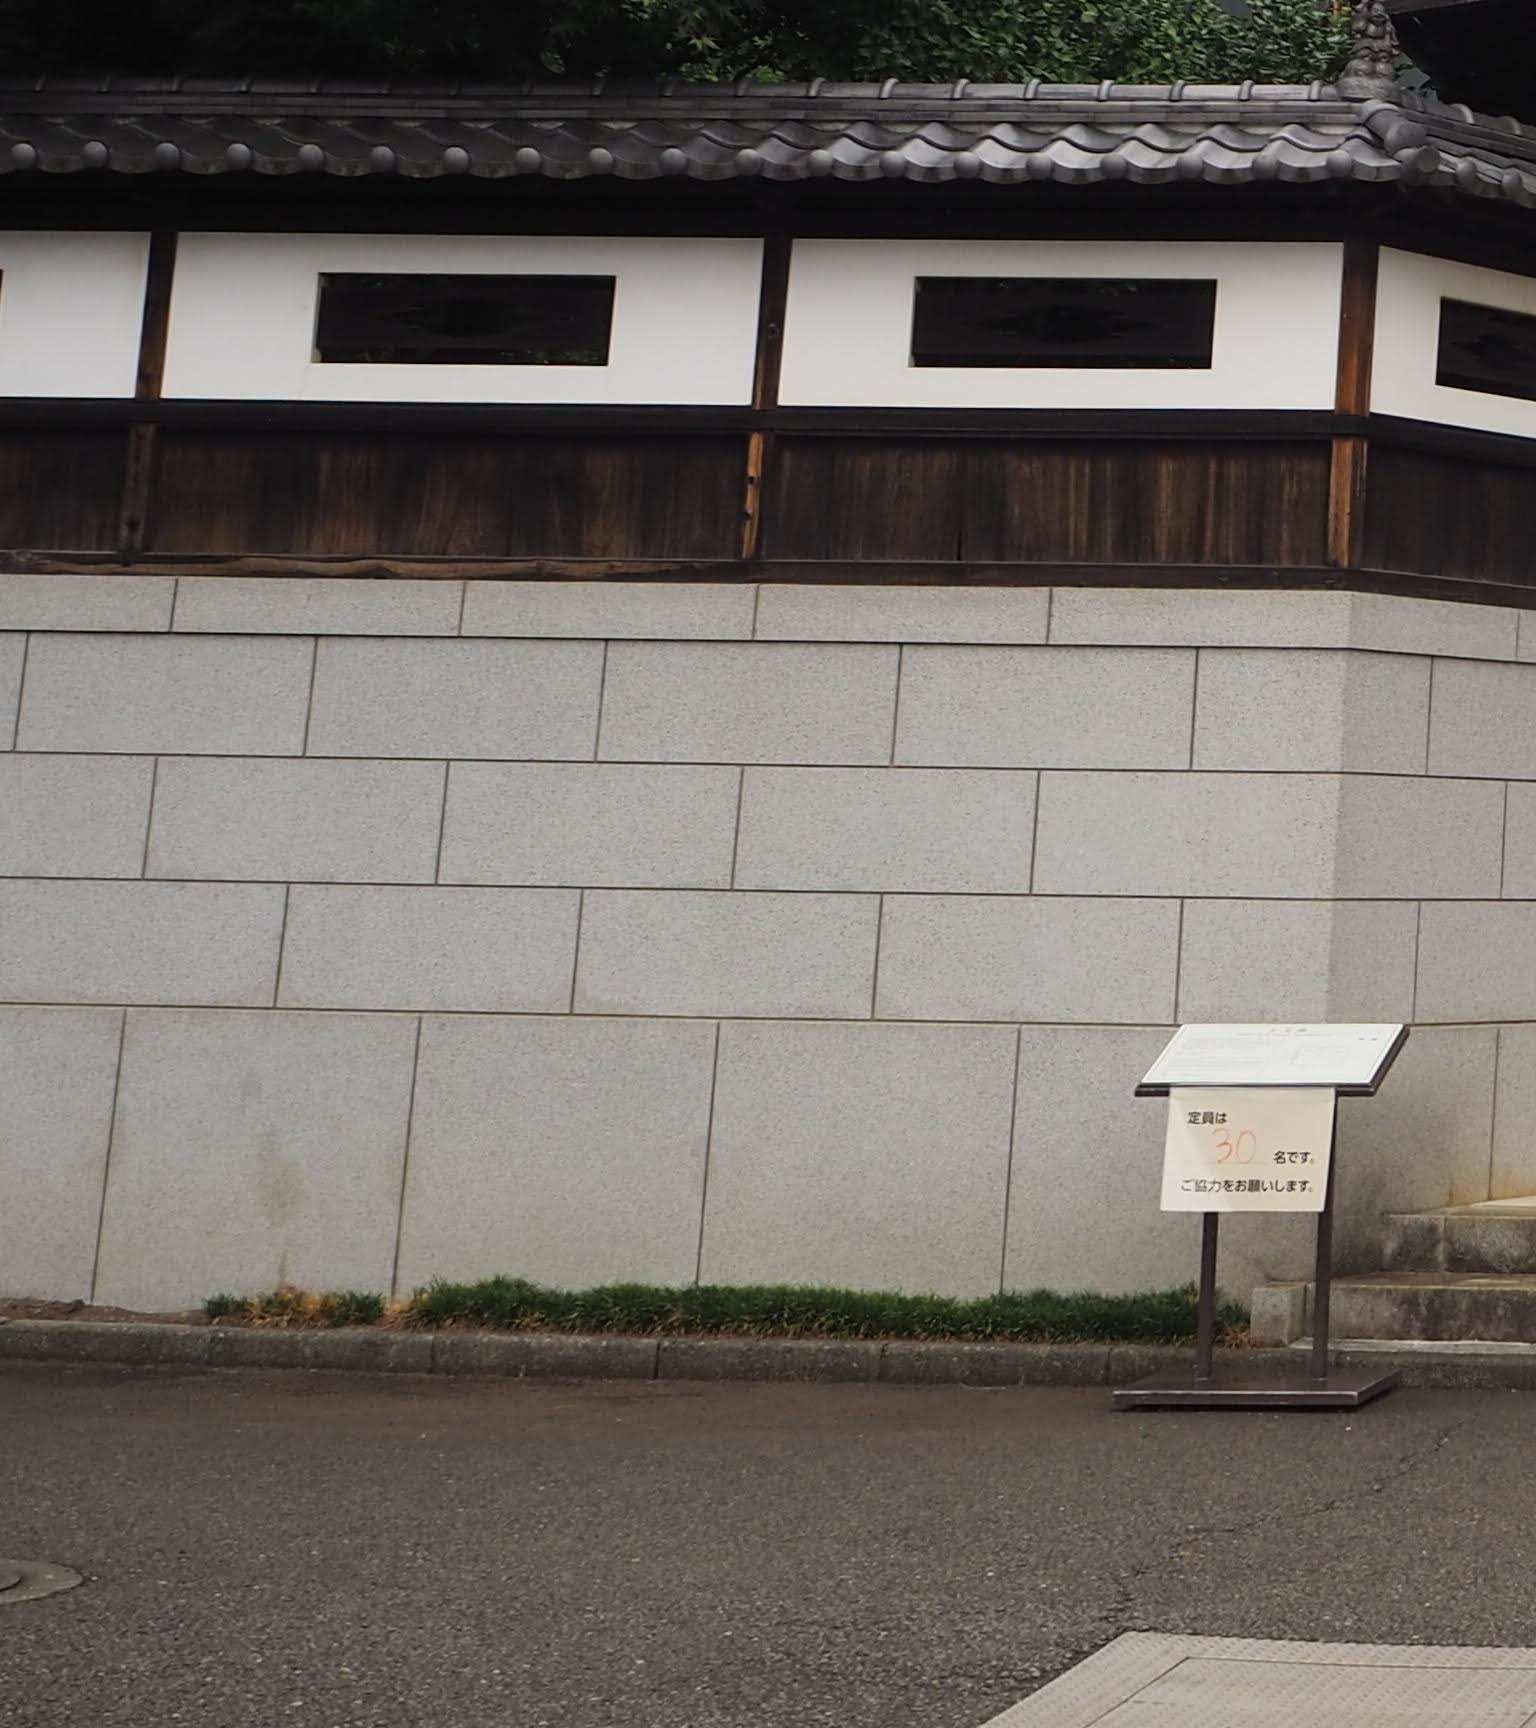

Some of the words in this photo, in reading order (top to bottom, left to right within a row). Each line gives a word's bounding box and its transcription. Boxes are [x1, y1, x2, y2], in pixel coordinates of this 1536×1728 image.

[1187, 1111, 1228, 1125] 定員は
[1211, 1127, 1257, 1164] 30
[1273, 1150, 1315, 1165] 名です。
[1181, 1179, 1314, 1193] ご協力をお願いします。
